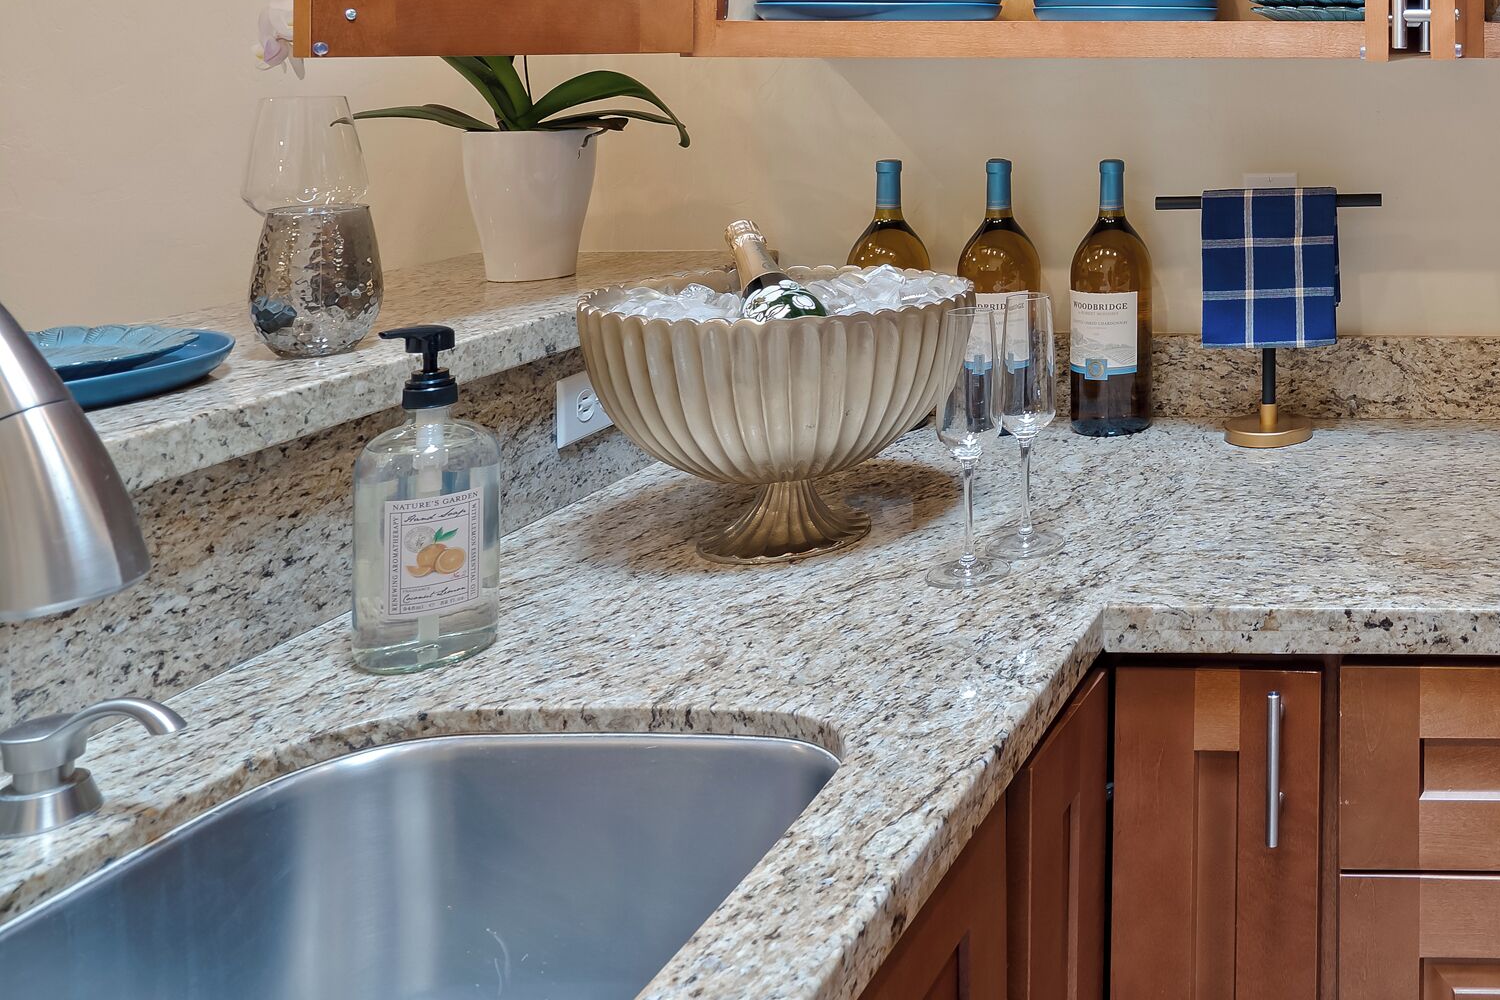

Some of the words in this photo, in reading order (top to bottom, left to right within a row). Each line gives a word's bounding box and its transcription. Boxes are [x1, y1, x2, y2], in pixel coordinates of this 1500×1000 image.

[1073, 301, 1128, 311] WOODBRIDGE
[392, 500, 440, 511] NATURE'S
[442, 490, 479, 505] GARDEN
